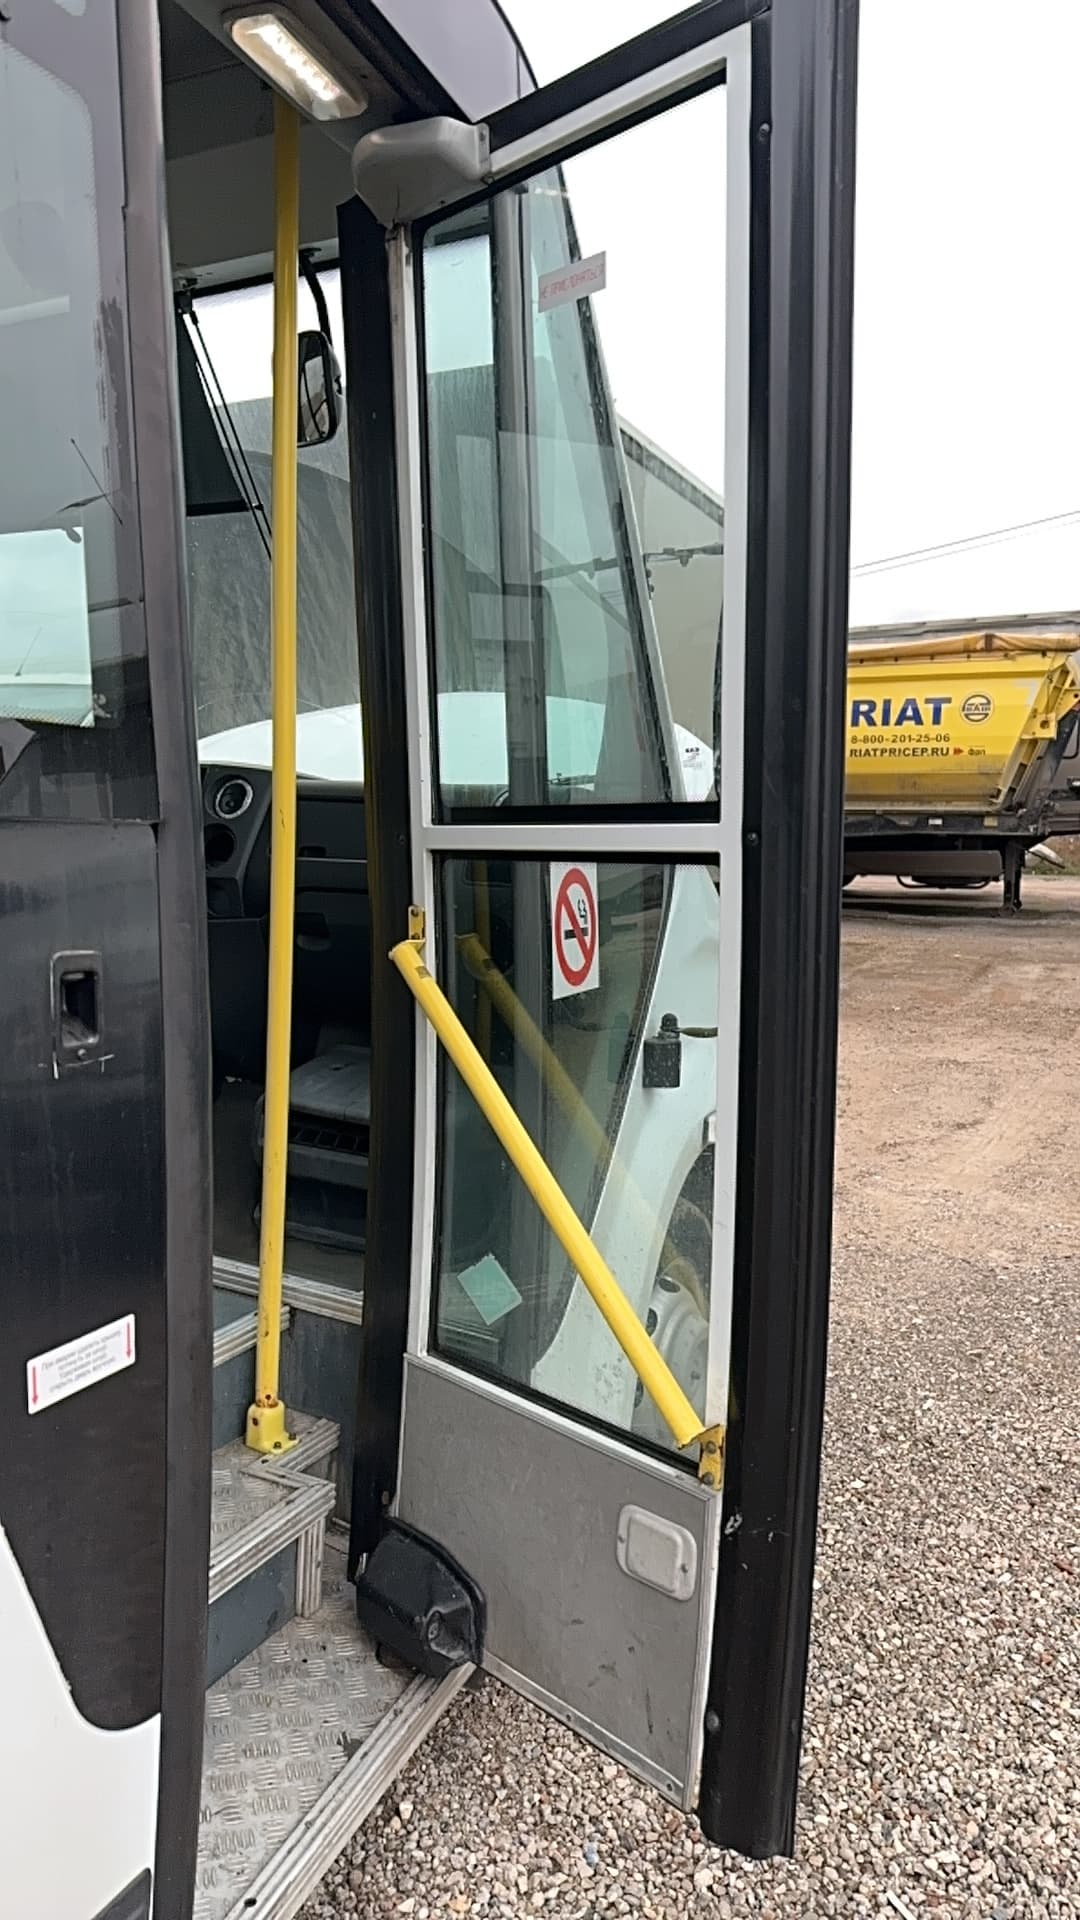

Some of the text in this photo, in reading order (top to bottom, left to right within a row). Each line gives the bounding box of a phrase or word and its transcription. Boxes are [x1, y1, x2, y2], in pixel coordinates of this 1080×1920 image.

[851, 697, 952, 727] RIAT
[851, 733, 950, 744] 8-800-201-25-06
[849, 747, 950, 758] RIATPRICEP.RU
